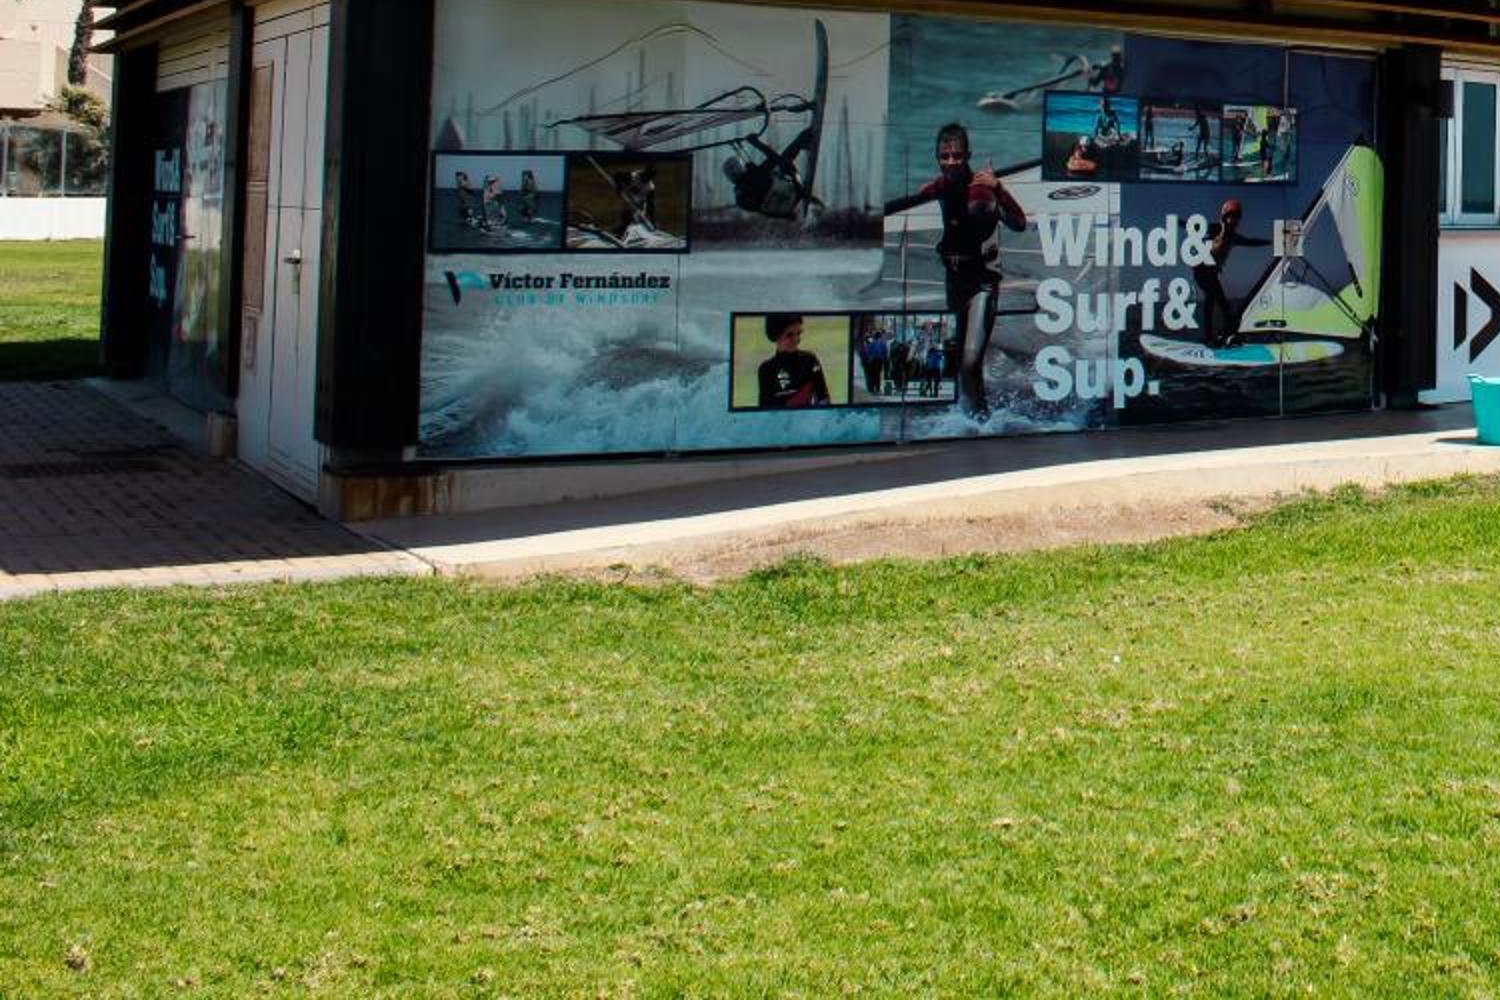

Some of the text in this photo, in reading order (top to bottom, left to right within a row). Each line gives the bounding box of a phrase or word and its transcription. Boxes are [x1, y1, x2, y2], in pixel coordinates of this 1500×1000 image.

[1037, 213, 1216, 267] Wind&
[488, 271, 672, 290] Víctor Fernández
[1034, 277, 1199, 333] Surf&
[1033, 345, 1160, 409] Sup.
